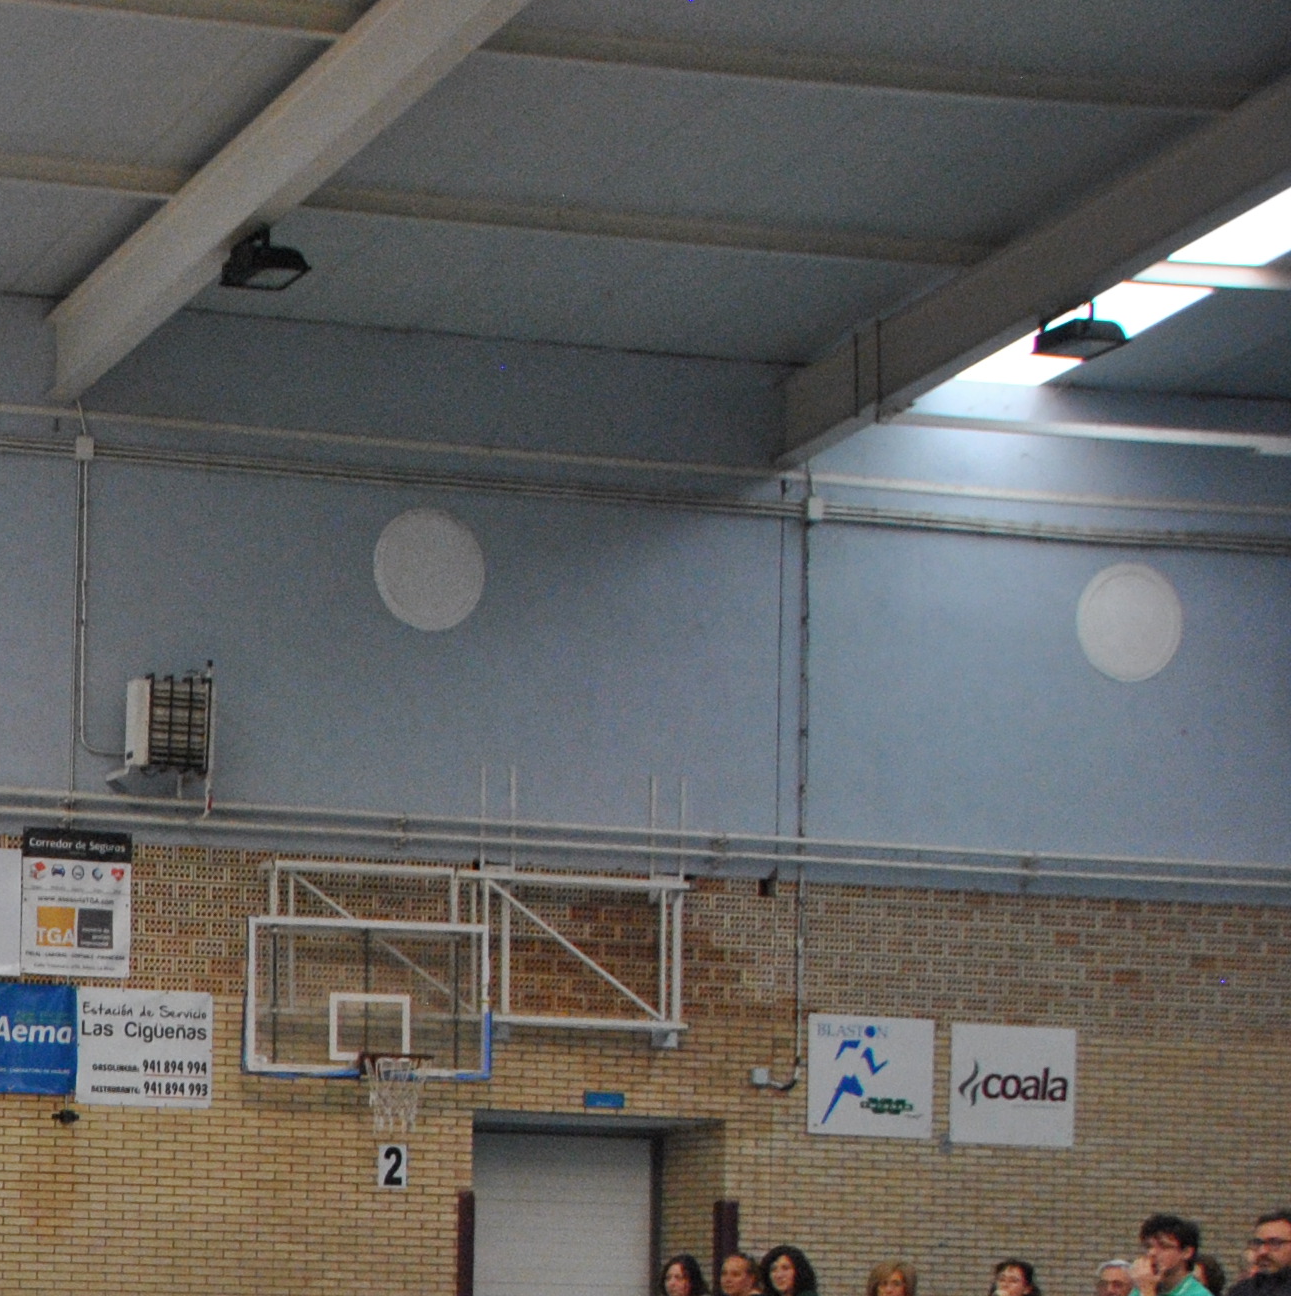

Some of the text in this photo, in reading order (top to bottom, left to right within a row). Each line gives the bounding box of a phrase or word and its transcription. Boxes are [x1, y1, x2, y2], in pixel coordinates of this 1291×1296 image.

[29, 837, 73, 849] Corredor
[75, 840, 86, 849] de
[89, 841, 126, 854] Seguros
[36, 927, 76, 946] TGA
[82, 1001, 207, 1020] Estación de Servicio
[81, 1019, 114, 1037] Las
[142, 1059, 161, 1073] 941
[164, 1060, 184, 1074] 894
[187, 1061, 207, 1075] 994
[143, 1081, 162, 1095] 941
[165, 1082, 185, 1096] 894
[188, 1083, 208, 1097] 993
[981, 1067, 1068, 1102] coala
[383, 1146, 403, 1186] 2
